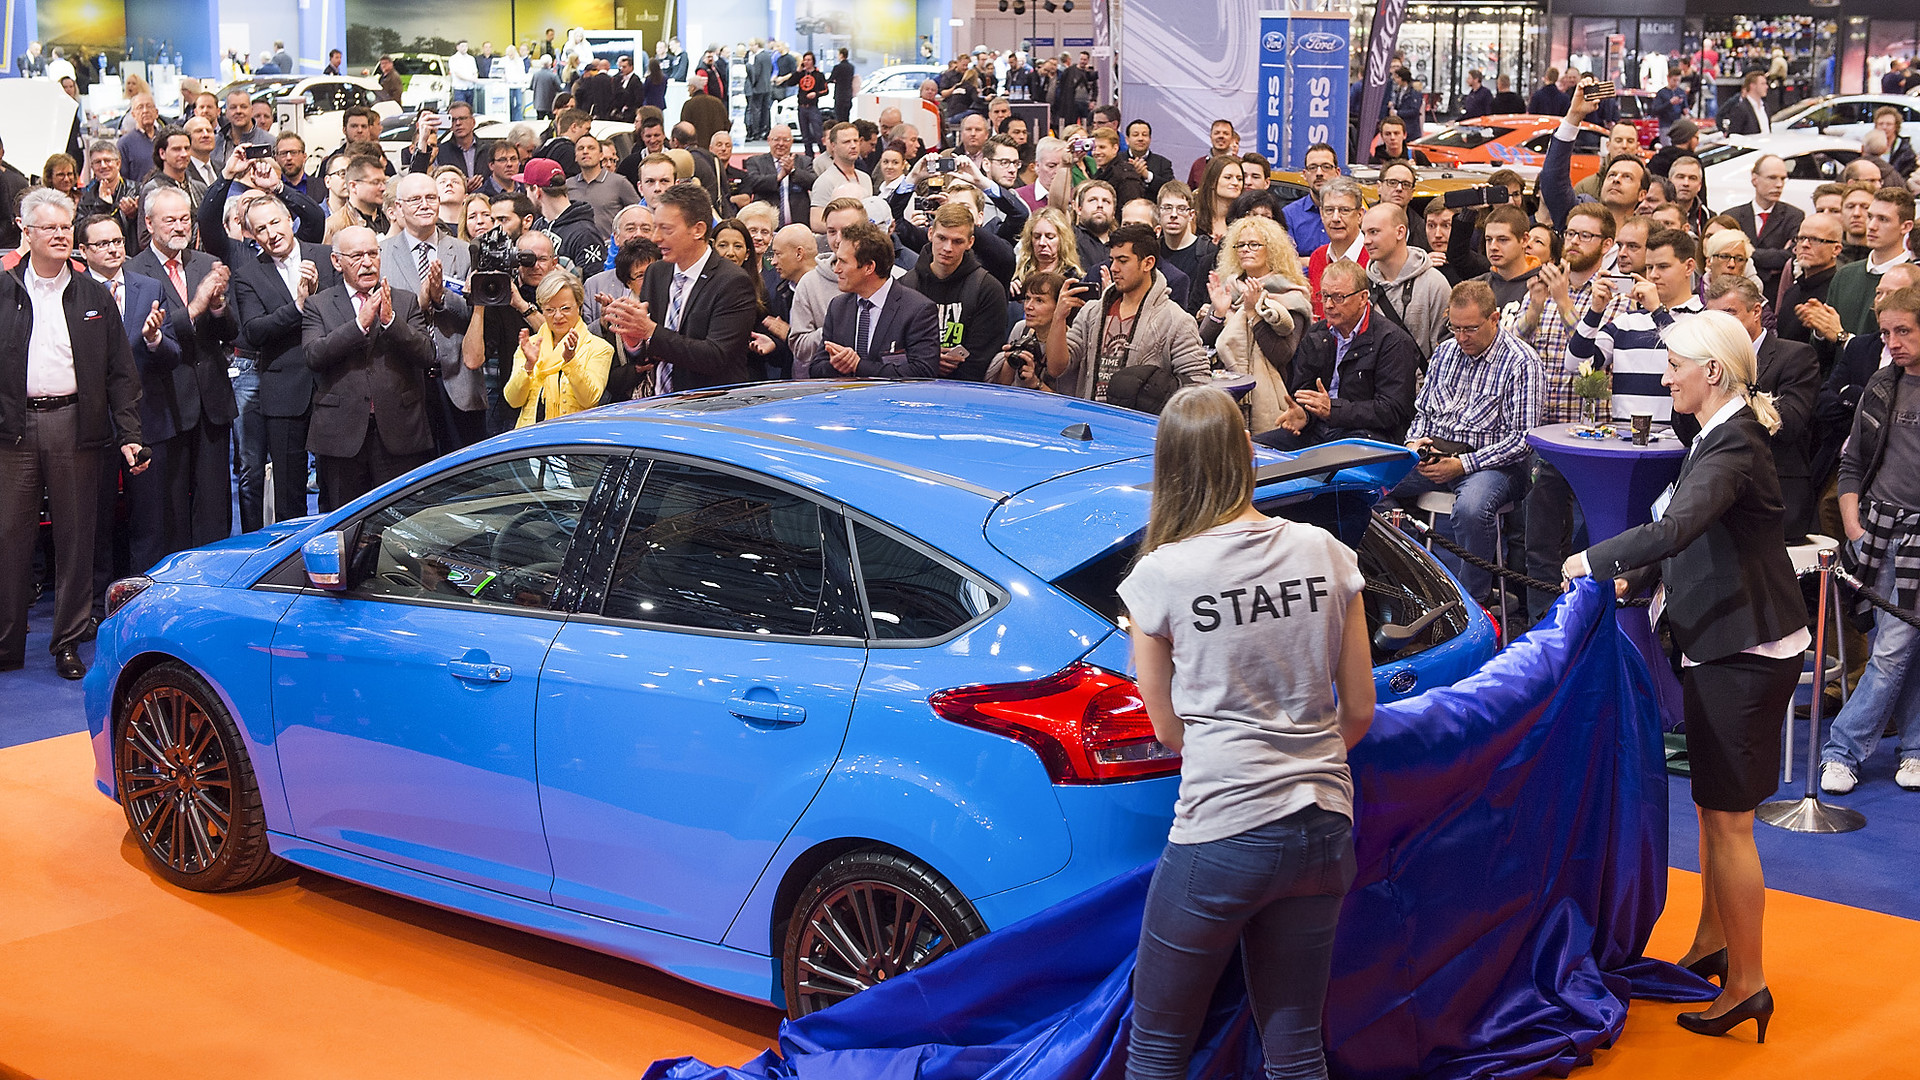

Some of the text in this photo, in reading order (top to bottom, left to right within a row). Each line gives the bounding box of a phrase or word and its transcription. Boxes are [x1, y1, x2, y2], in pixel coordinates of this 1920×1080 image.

[1266, 34, 1283, 49] Ford
[1305, 36, 1337, 50] Ford
[1268, 75, 1280, 116] RS
[1309, 77, 1331, 118] RS
[944, 321, 964, 344] 79
[1191, 576, 1328, 632] STAFF
